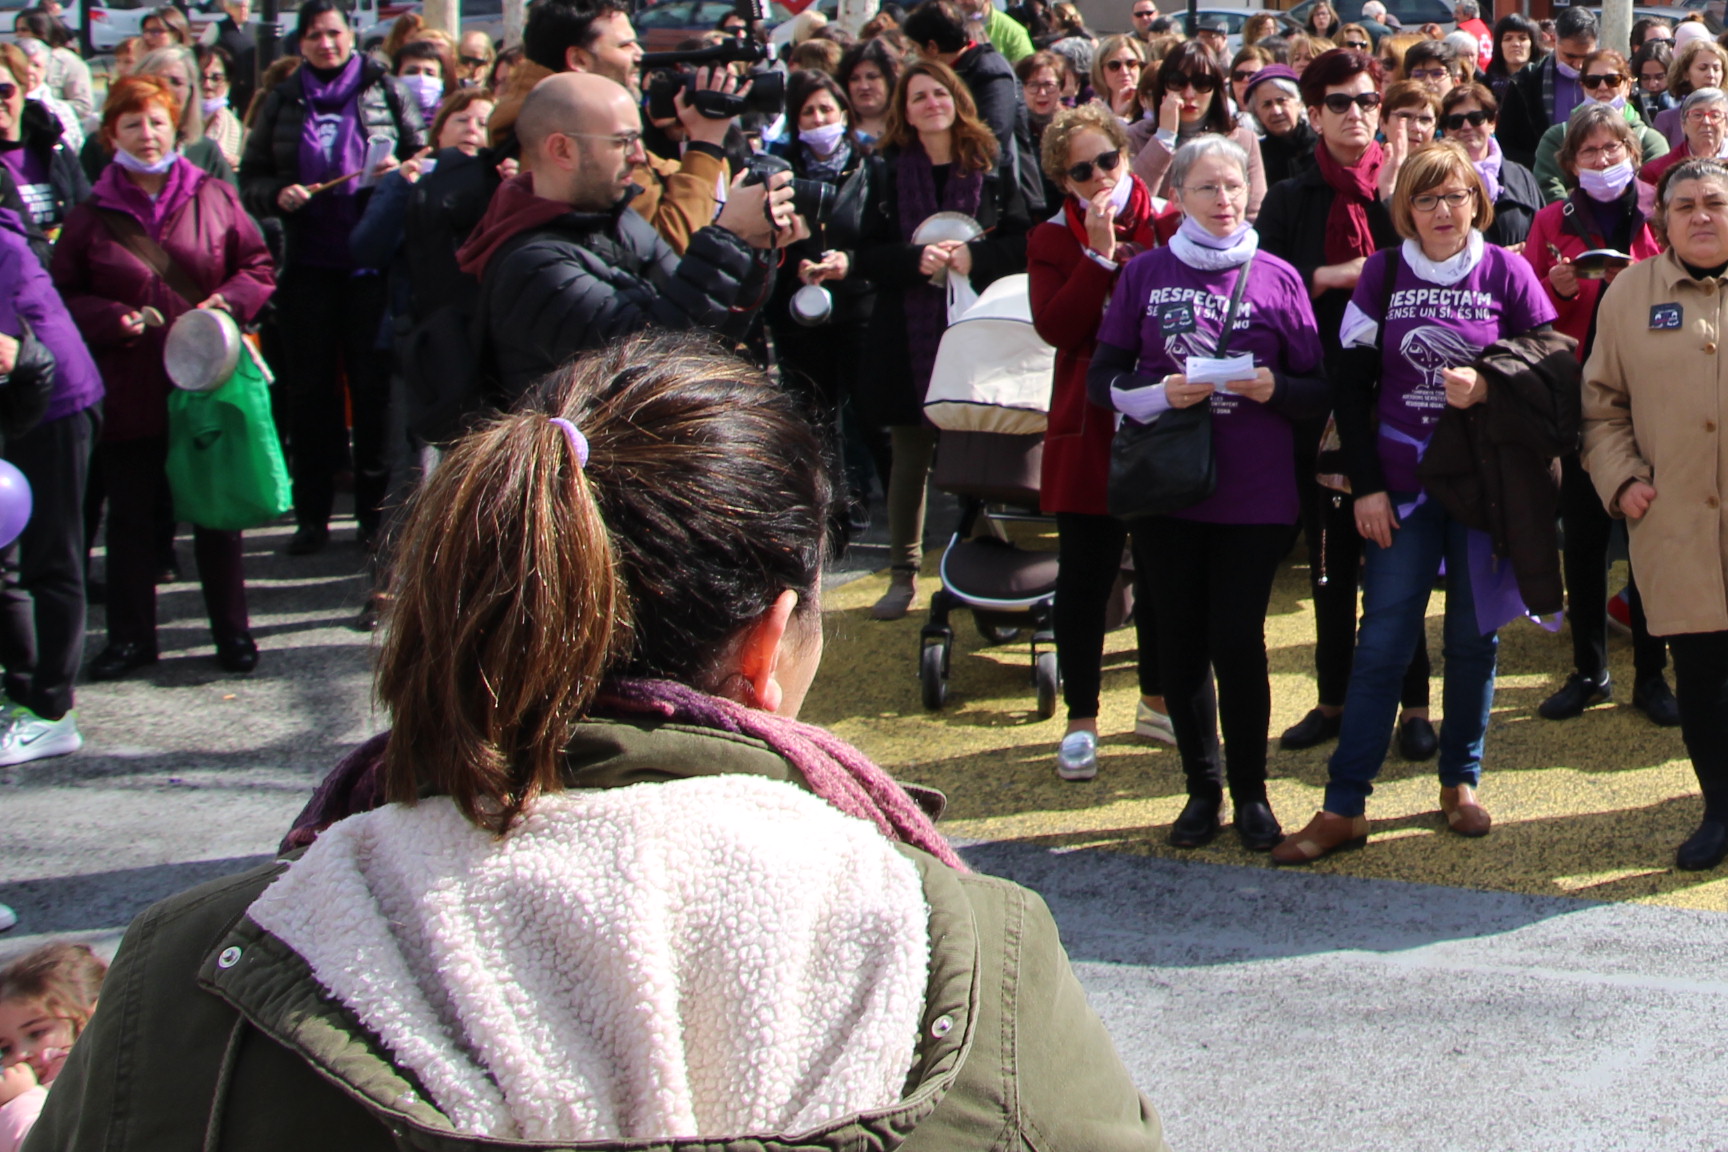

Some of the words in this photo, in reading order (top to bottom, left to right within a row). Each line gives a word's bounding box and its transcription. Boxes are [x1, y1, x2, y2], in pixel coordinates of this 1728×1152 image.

[1149, 287, 1252, 318] RESPECTAM
[1386, 306, 1417, 320] ENSE
[1419, 307, 1436, 318] UN
[1475, 308, 1491, 320] NO
